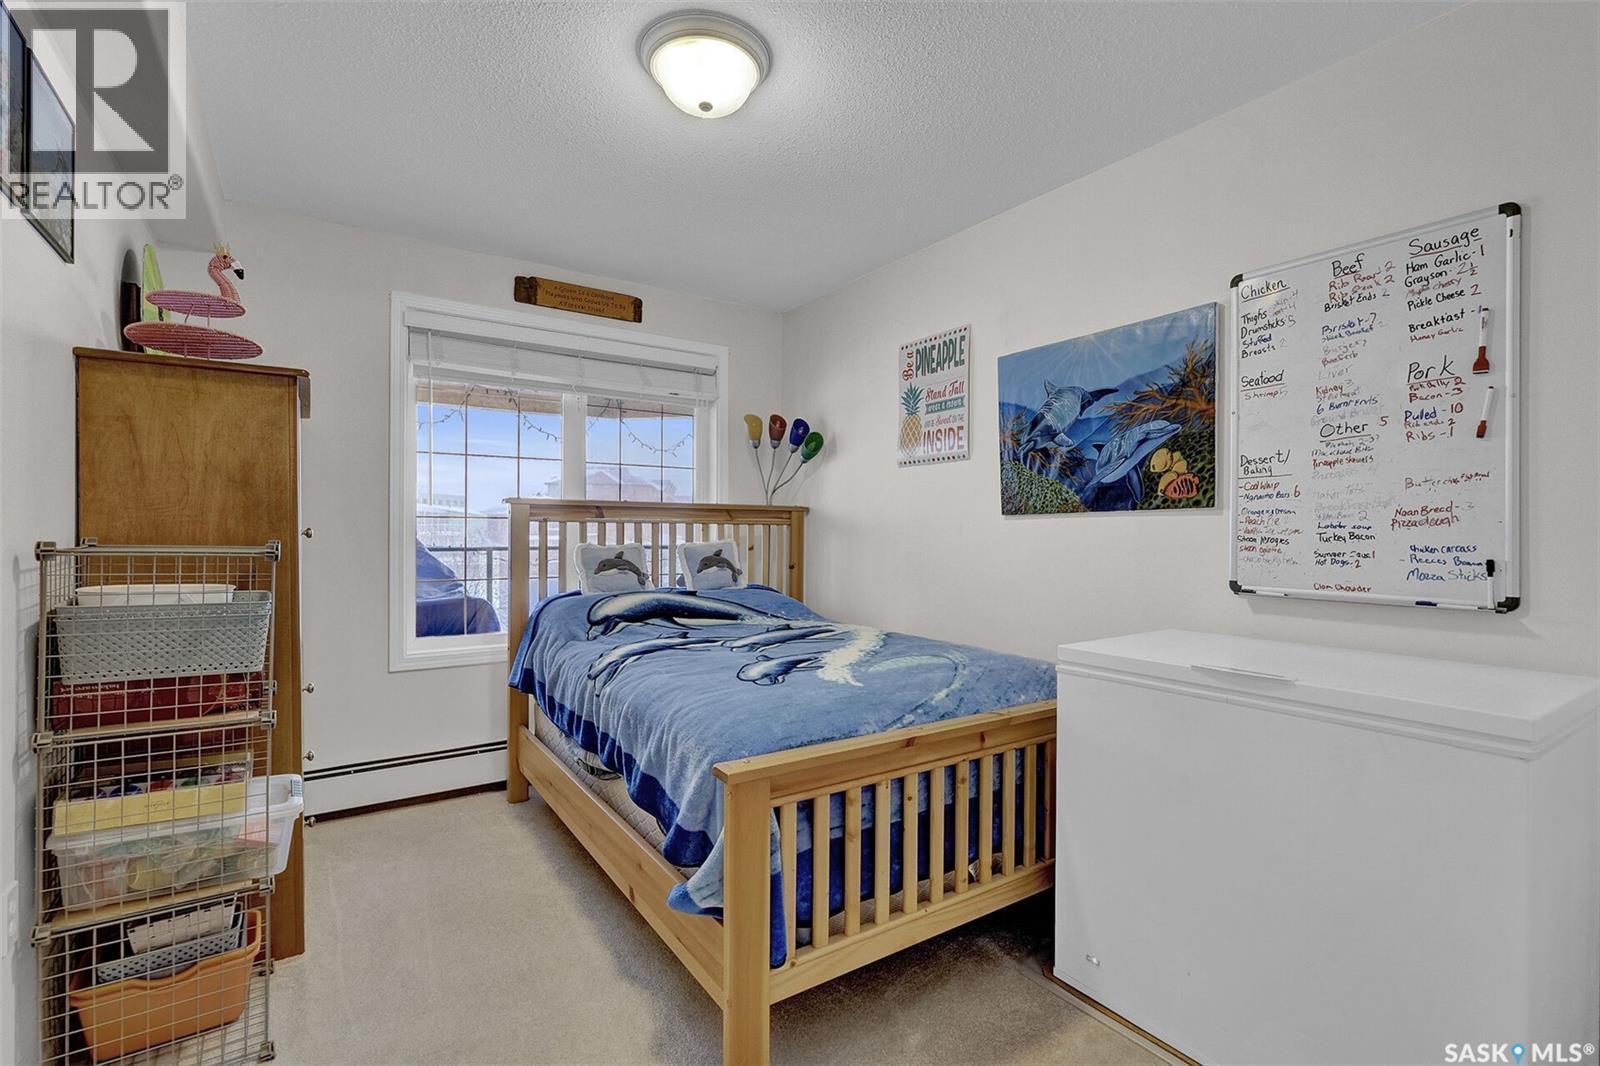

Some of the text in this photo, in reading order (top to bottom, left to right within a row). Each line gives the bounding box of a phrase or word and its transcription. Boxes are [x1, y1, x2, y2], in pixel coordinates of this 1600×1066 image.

[1409, 228, 1479, 255] Sausage
[1331, 253, 1365, 277] Beef
[1406, 262, 1428, 275] Ham
[1329, 279, 1349, 292] Rib
[1384, 261, 1396, 271] 2
[1384, 275, 1395, 284] 2
[1241, 280, 1286, 299] Chicken
[1356, 292, 1376, 302] Ends
[1407, 298, 1433, 311] Pickle
[1436, 289, 1465, 302] Cheese
[1471, 284, 1481, 296] 2
[1408, 308, 1465, 333] Breakfast
[1242, 334, 1272, 349] Stuffed
[915, 335, 966, 378] PINEAPPLE
[1241, 344, 1276, 359] Breasts
[902, 361, 914, 382] Be
[1408, 355, 1455, 383] Pork
[1241, 370, 1284, 388] Seafood
[925, 381, 964, 402] Stand Tall
[1315, 384, 1343, 395] Kidney
[1409, 391, 1443, 402] Bacon
[1316, 404, 1324, 414] 6
[1379, 416, 1389, 426] 5
[1320, 422, 1368, 437] Other
[923, 426, 964, 454] INSIDE
[1294, 485, 1301, 498] 6
[1316, 532, 1376, 542] Turkey Bacon
[1354, 560, 1361, 568] 2
[1407, 568, 1488, 581] Mozza Sticks
